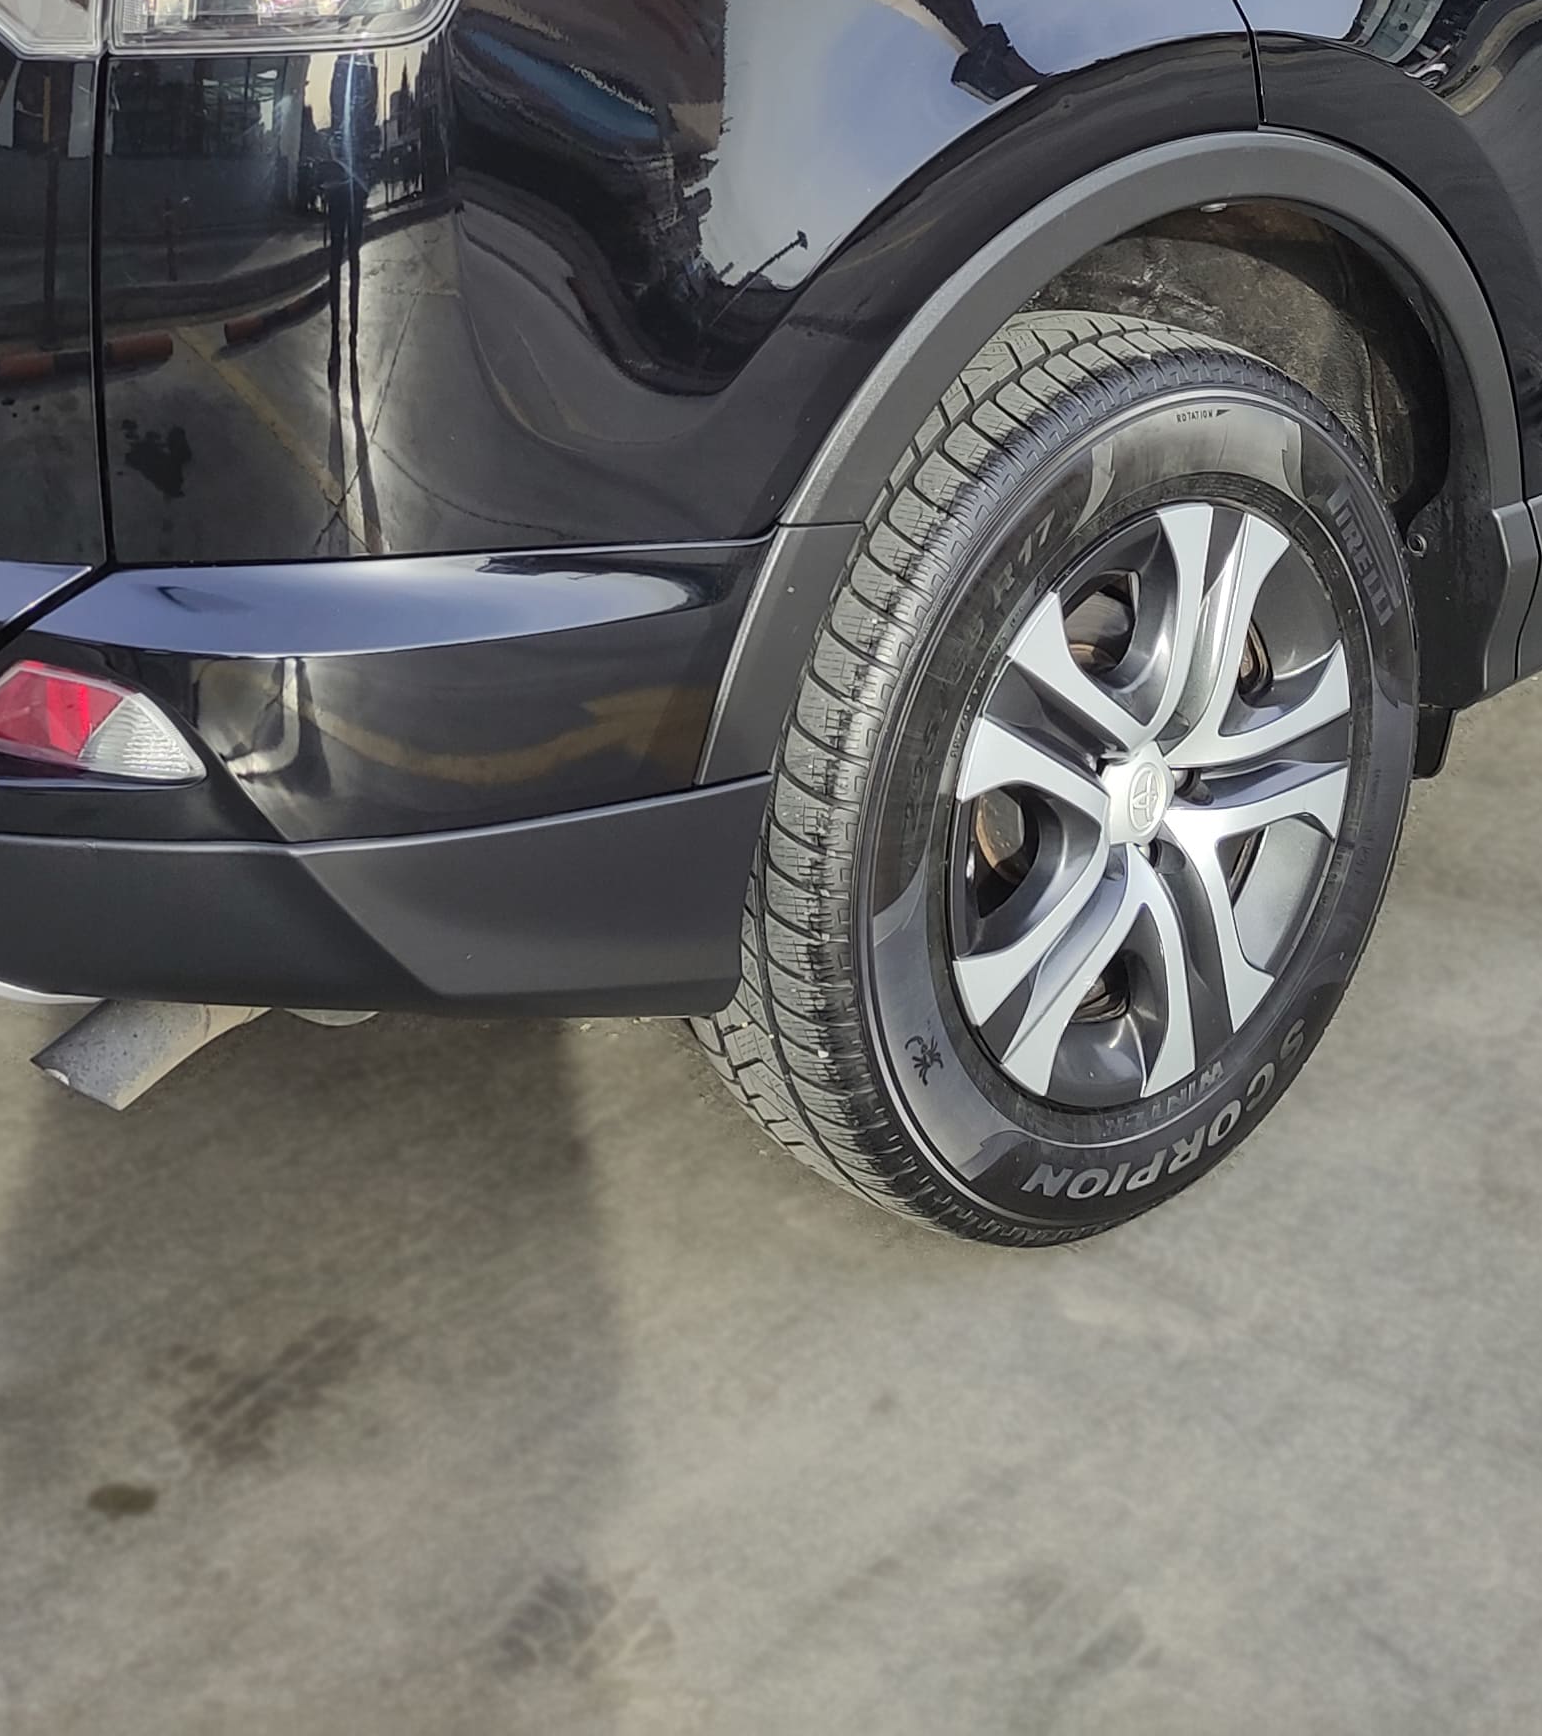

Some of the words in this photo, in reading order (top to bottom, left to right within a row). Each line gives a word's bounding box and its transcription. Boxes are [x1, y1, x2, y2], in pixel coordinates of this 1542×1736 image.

[1176, 409, 1213, 423] ROTATION
[1326, 475, 1400, 626] PIRELLI
[1020, 1018, 1306, 1200] SCORPION
